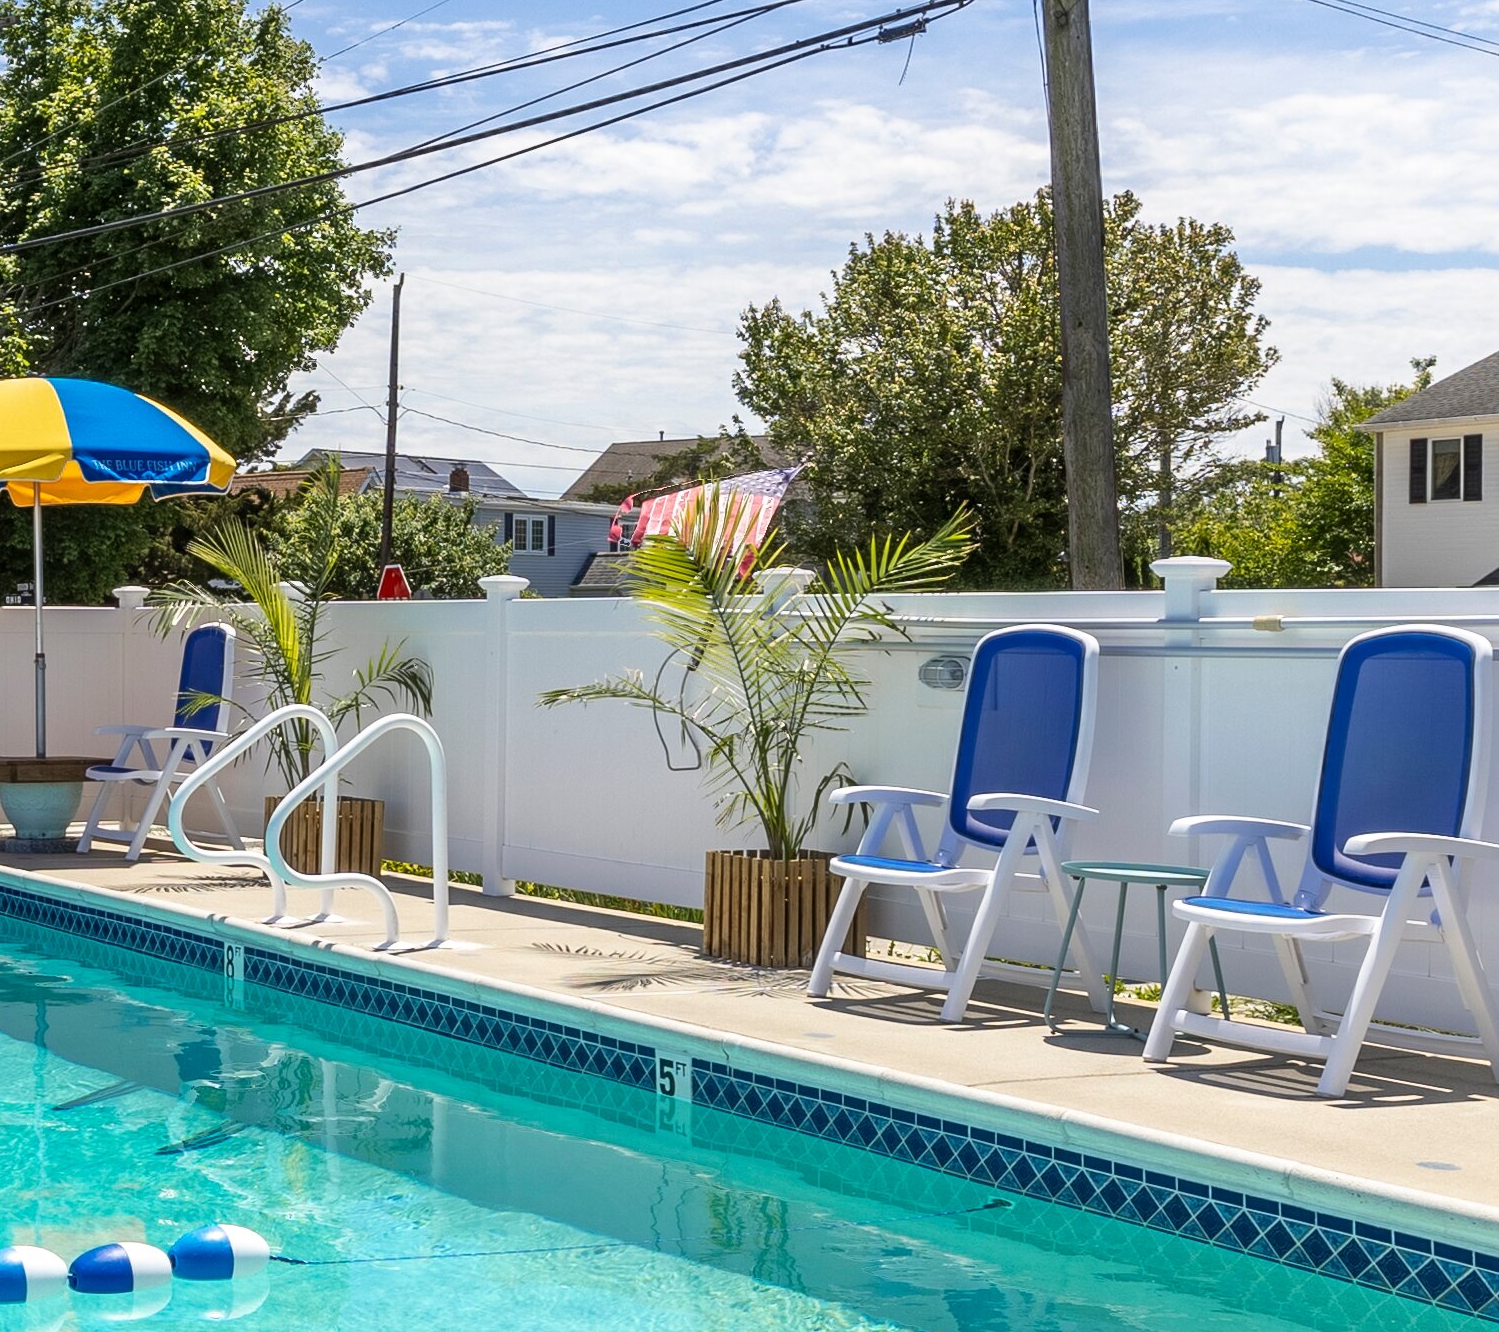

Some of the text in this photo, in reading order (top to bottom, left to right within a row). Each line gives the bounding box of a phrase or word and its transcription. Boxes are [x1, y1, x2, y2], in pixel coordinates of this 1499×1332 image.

[115, 459, 145, 472] BLUE
[147, 460, 174, 472] FISH
[176, 460, 197, 472] INN
[226, 945, 241, 978] 8 FT
[659, 1058, 687, 1097] 5 FT
